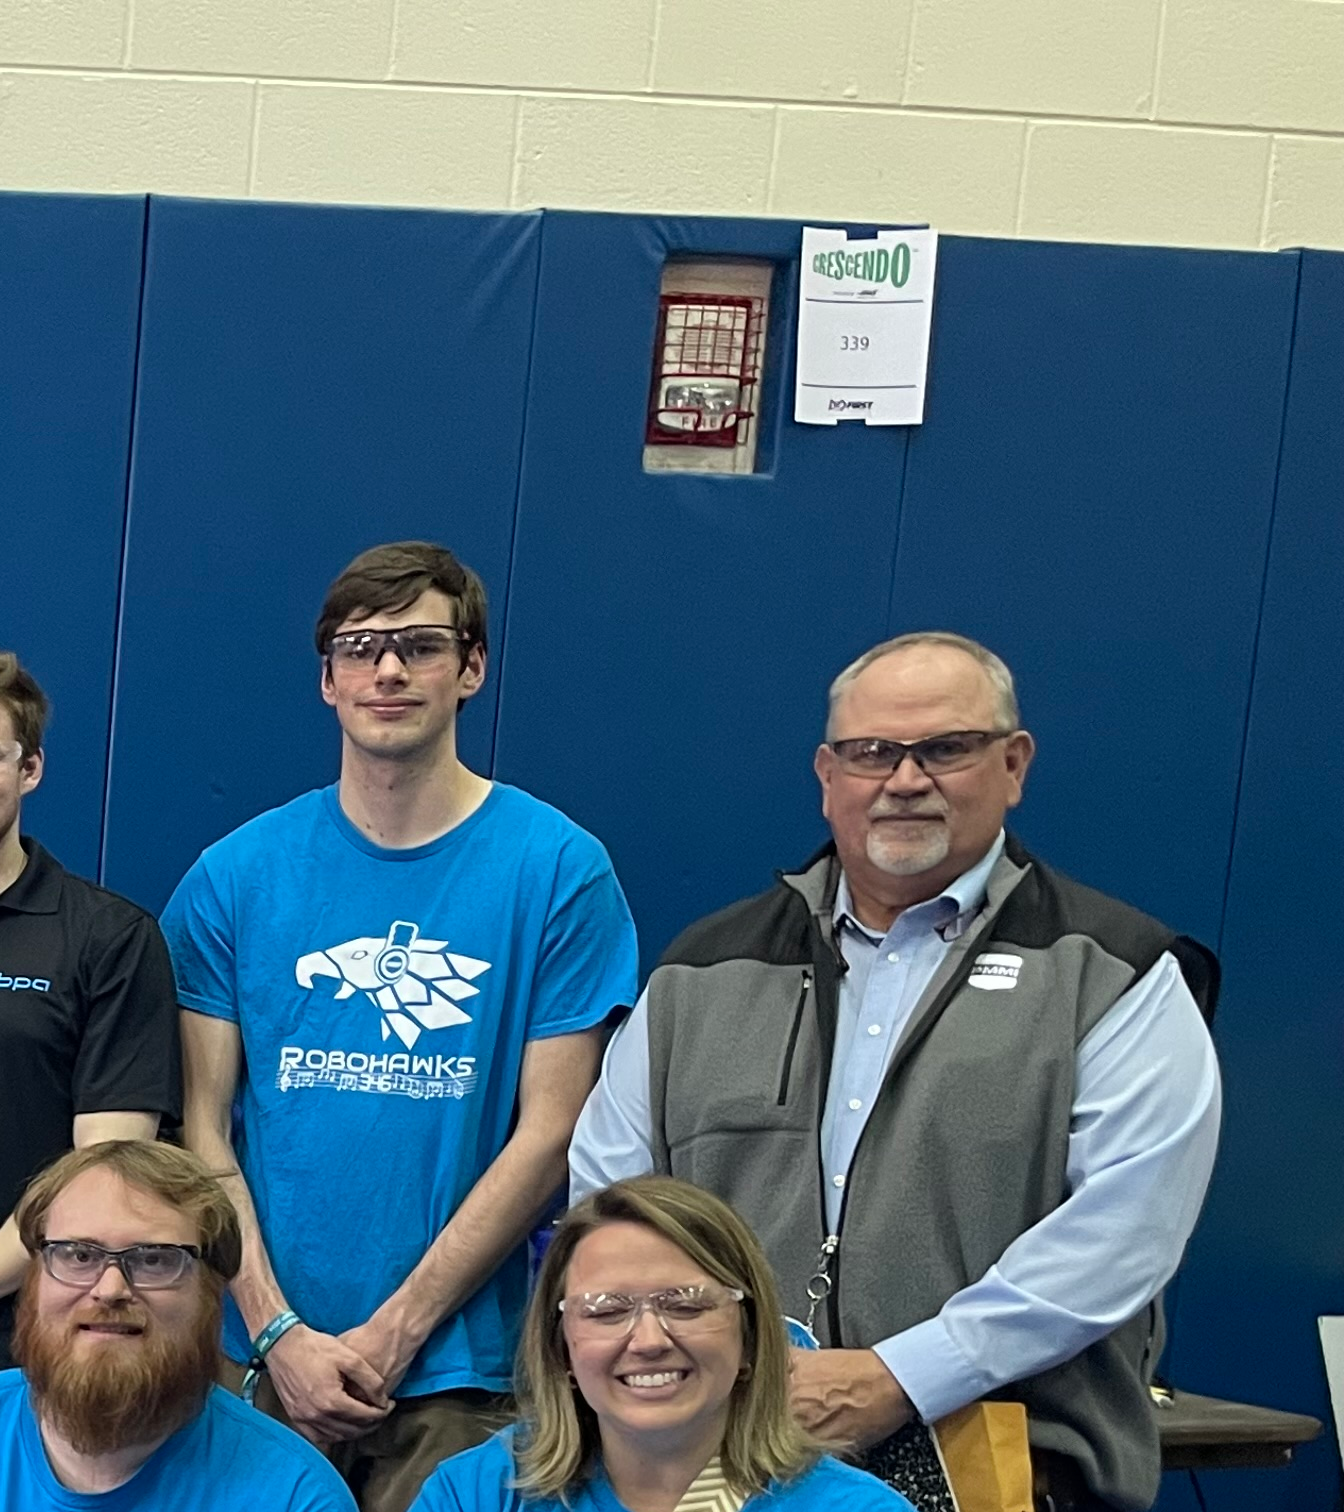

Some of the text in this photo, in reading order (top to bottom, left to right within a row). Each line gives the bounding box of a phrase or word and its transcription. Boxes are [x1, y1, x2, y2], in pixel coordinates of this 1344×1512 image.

[812, 242, 910, 288] CRESCENDO
[840, 336, 869, 351] 339
[279, 1046, 476, 1079] ROBOHAWKS
[360, 1074, 392, 1092] 346
